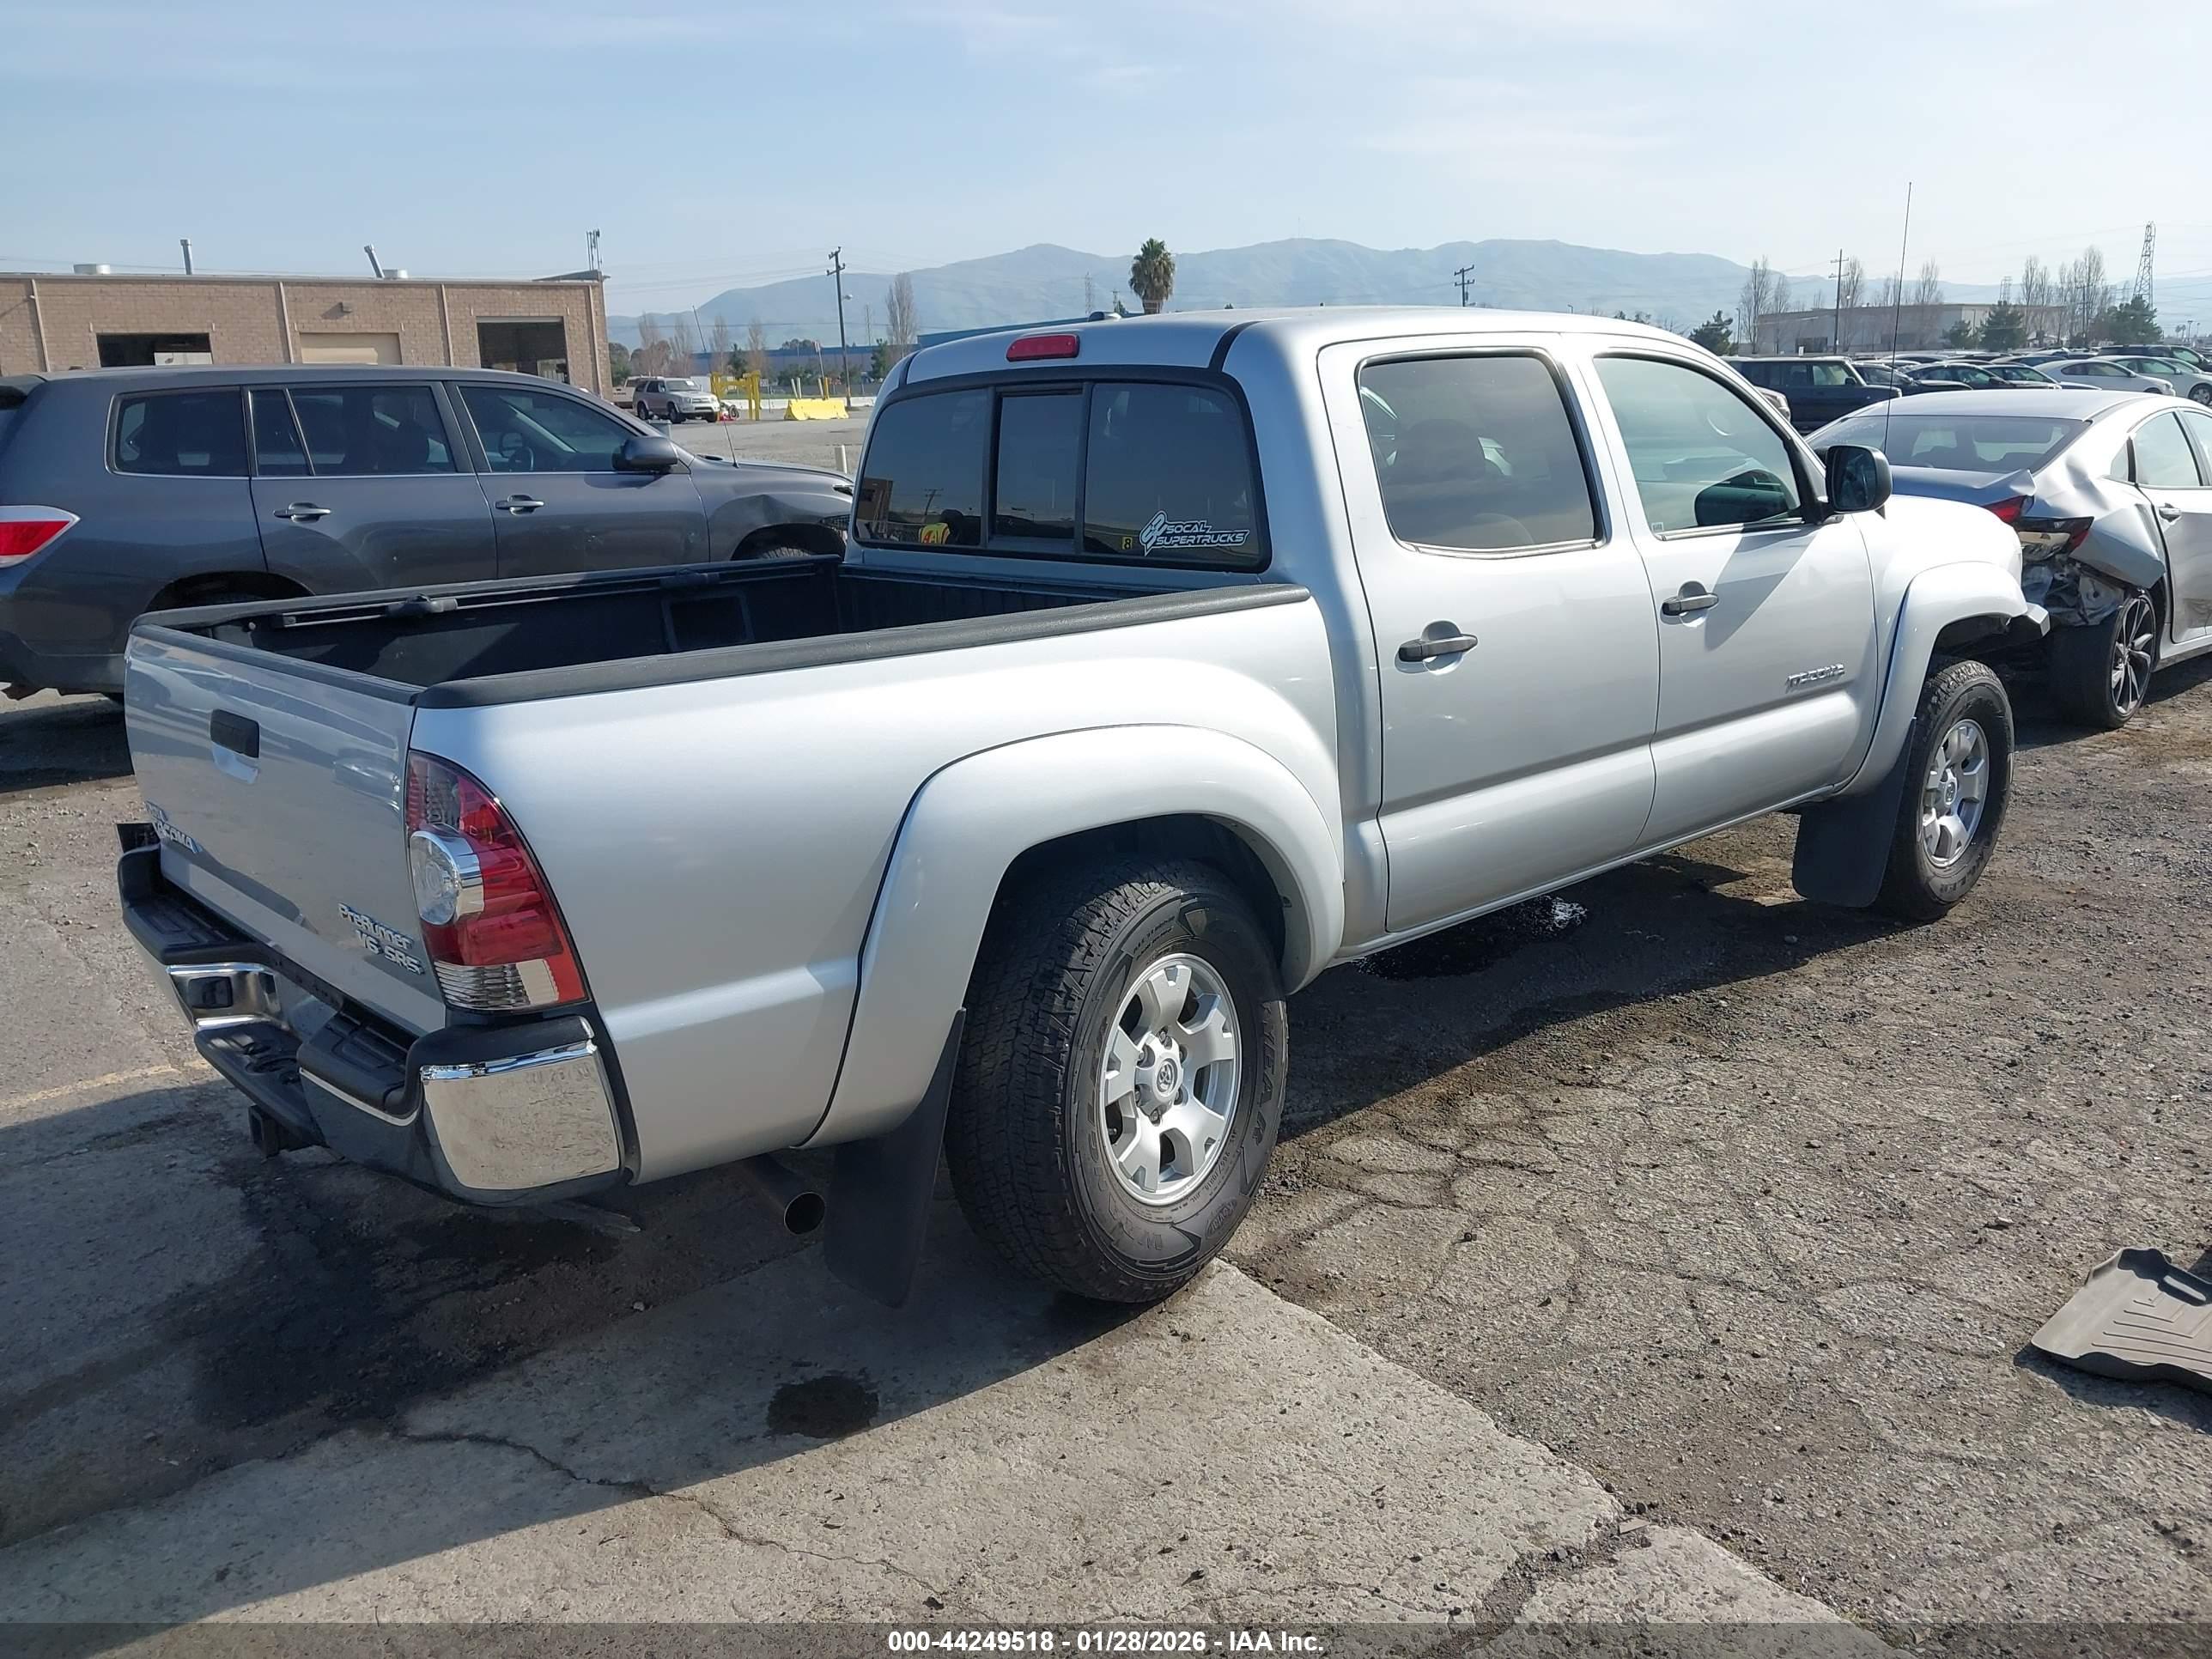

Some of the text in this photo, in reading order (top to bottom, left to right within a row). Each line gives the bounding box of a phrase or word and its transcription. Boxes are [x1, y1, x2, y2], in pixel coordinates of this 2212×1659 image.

[1155, 532, 1245, 545] SUPERTRUCKS
[1165, 522, 1206, 535] SOCAL
[338, 902, 412, 950] PreRunner
[355, 929, 425, 975] V6 SR5
